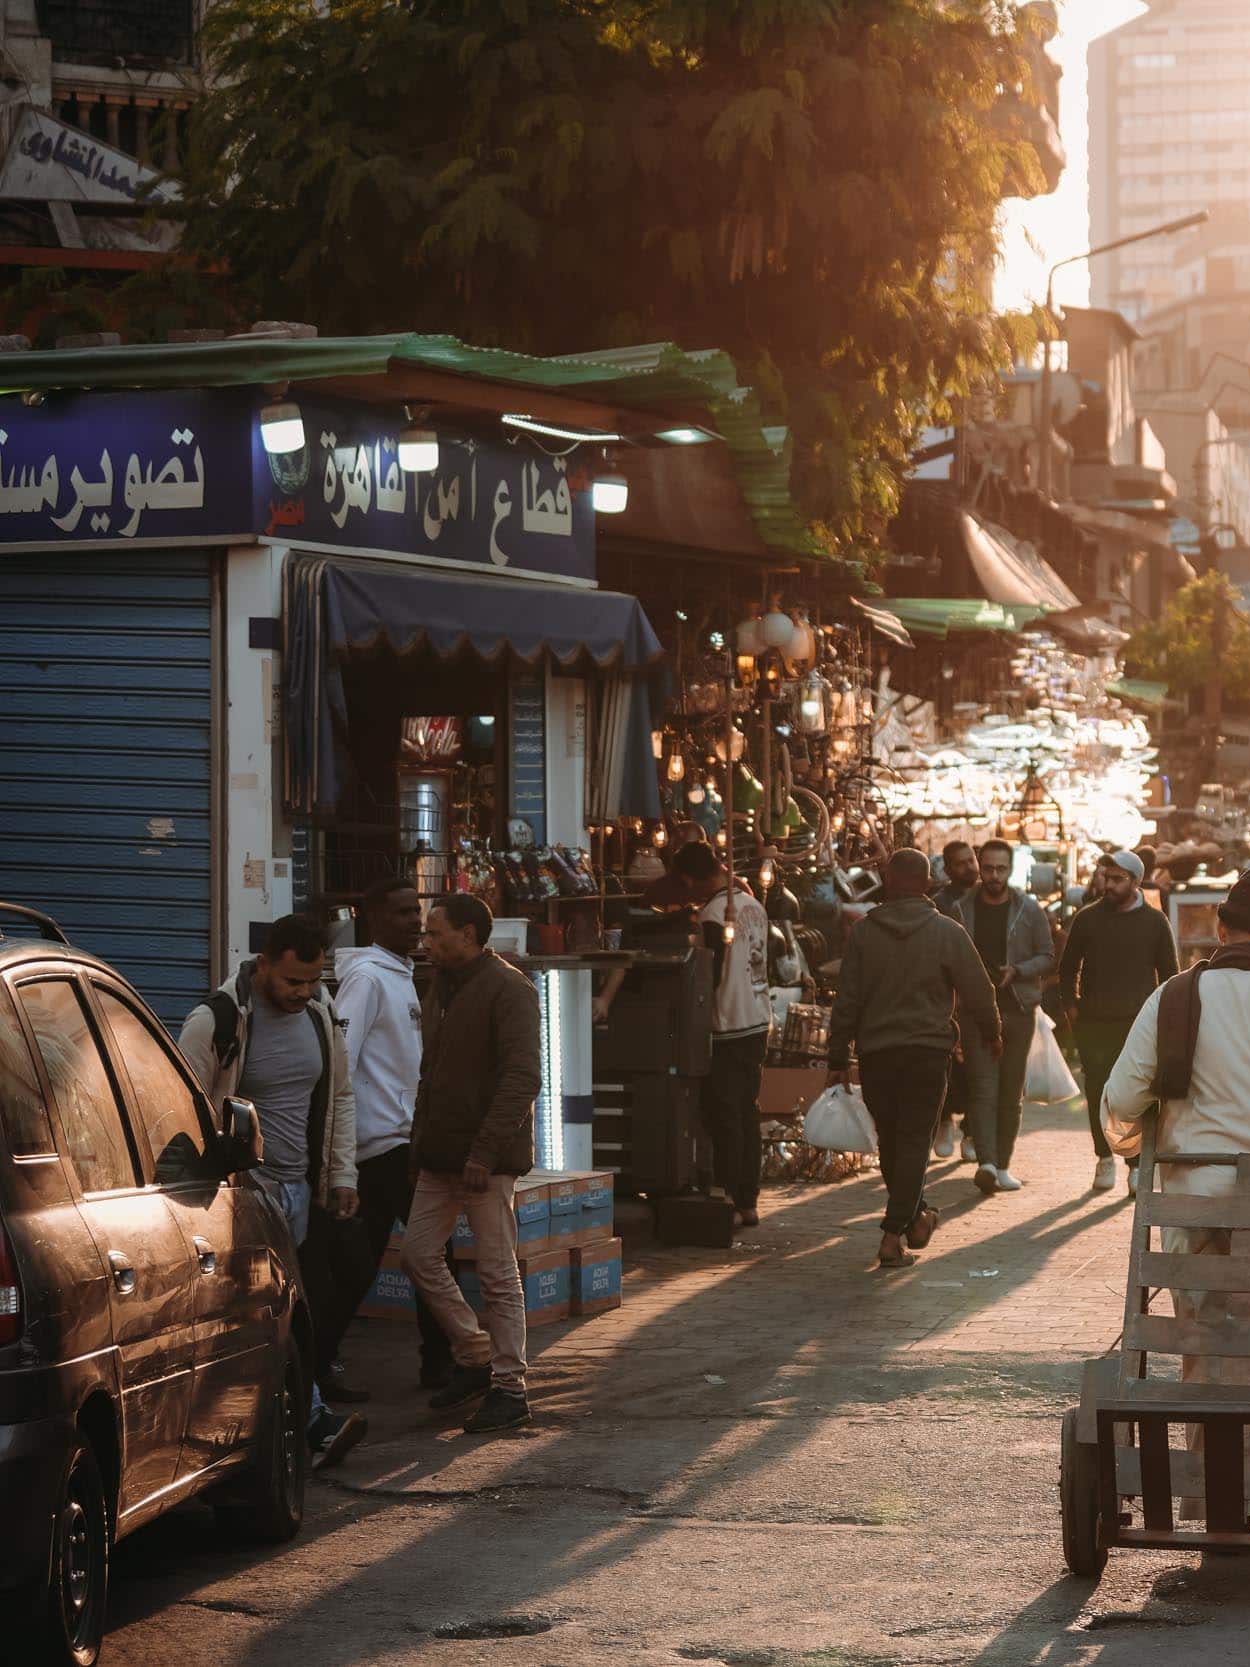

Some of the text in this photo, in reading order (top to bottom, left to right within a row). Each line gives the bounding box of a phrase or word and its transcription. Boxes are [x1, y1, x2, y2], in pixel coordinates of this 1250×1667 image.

[50, 428, 205, 537] تصوير
[490, 455, 572, 566] قطاع
[376, 1286, 410, 1298] DELTA
[377, 1272, 411, 1286] AQUA
